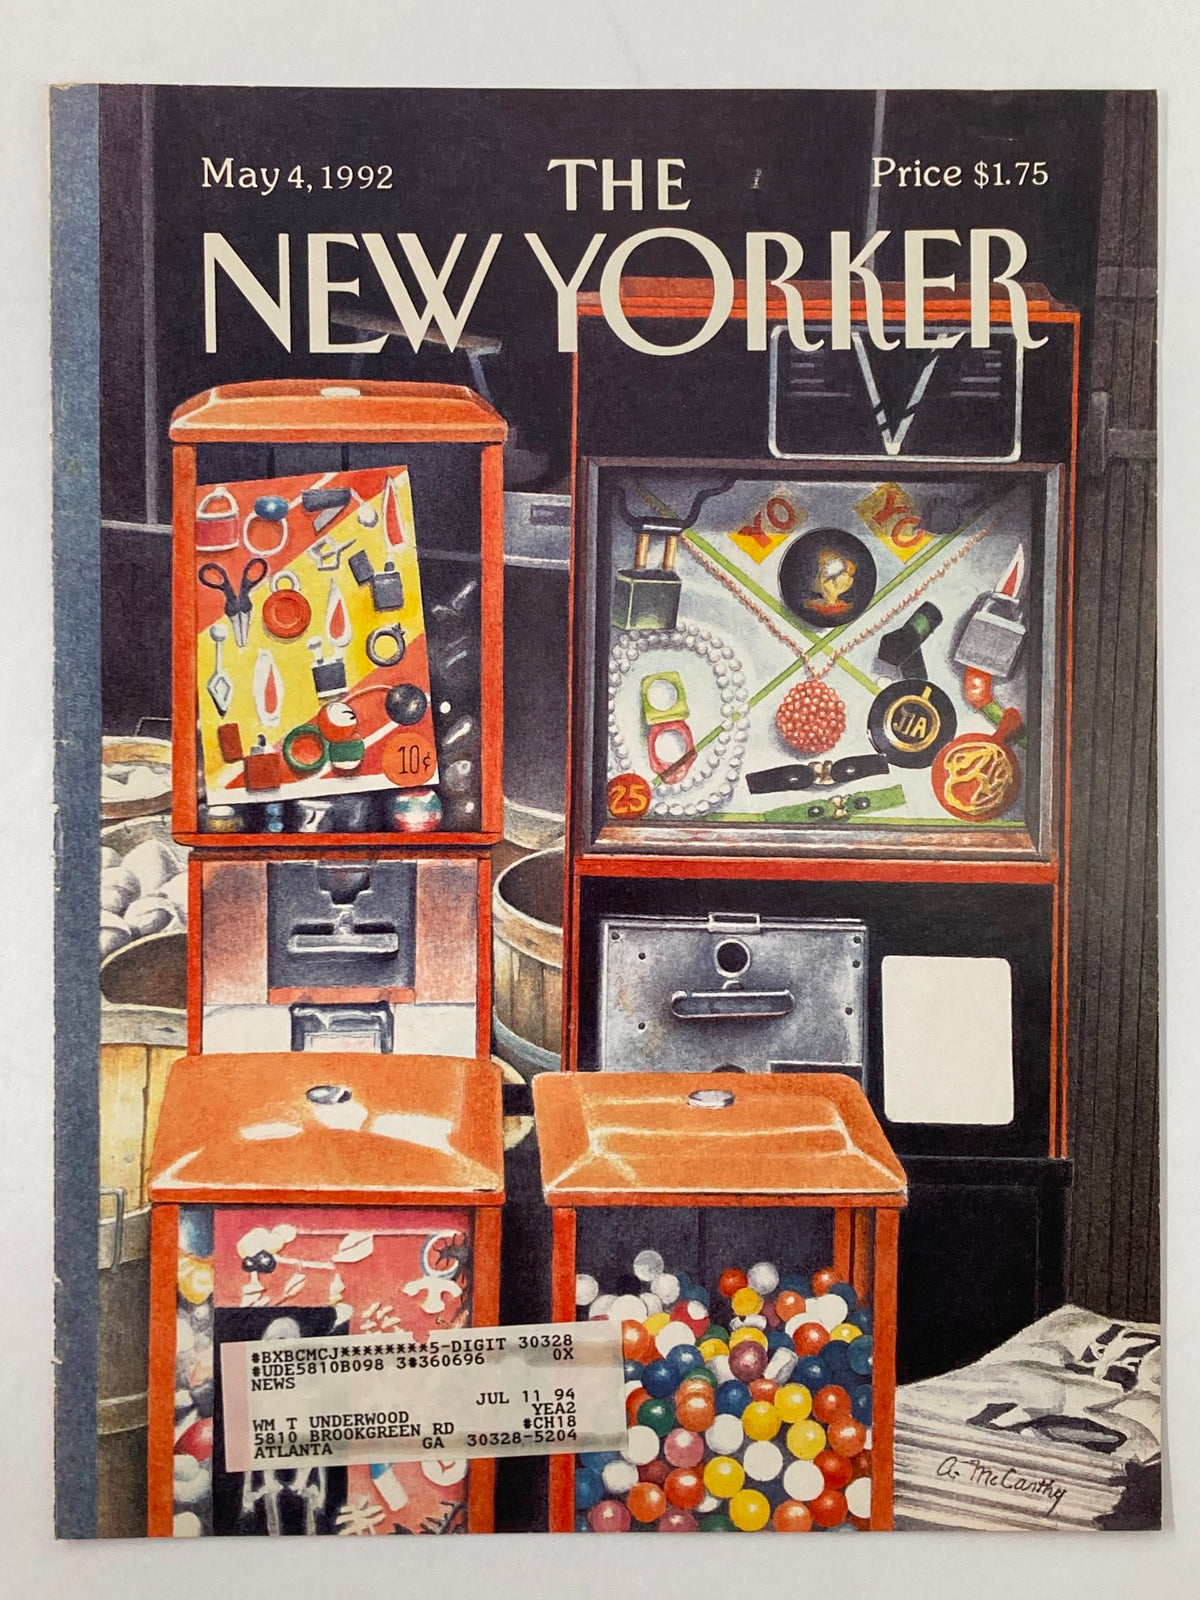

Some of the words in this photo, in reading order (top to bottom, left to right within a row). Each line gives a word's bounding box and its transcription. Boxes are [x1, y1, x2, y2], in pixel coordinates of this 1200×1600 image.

[201, 156, 281, 196] May
[287, 164, 313, 193] 4,
[321, 164, 394, 190] 1992
[547, 158, 691, 211] THE
[871, 156, 962, 188] Price
[973, 160, 1049, 189] $1.75
[203, 231, 503, 355] NEW
[524, 226, 1050, 356] YORKER
[398, 744, 432, 775] 10¢
[608, 784, 648, 814] 25
[518, 1334, 573, 1349] 30328
[396, 1352, 485, 1370] 3#360696
[251, 1376, 296, 1391] NEWS
[476, 1391, 510, 1406] JUL
[522, 1389, 540, 1403] 11
[554, 1387, 575, 1401] 94
[532, 1401, 577, 1416] YEA2
[252, 1418, 275, 1432] WM
[286, 1417, 298, 1430] T
[309, 1410, 409, 1429] UNDERWOOD
[523, 1415, 577, 1430] #CH18
[254, 1431, 297, 1446] 5810
[309, 1423, 421, 1443] BROOKGREEN
[432, 1422, 454, 1436] RD
[254, 1443, 333, 1459] ATLANTA
[422, 1436, 445, 1449] GA
[467, 1428, 577, 1447] 30328-5204
